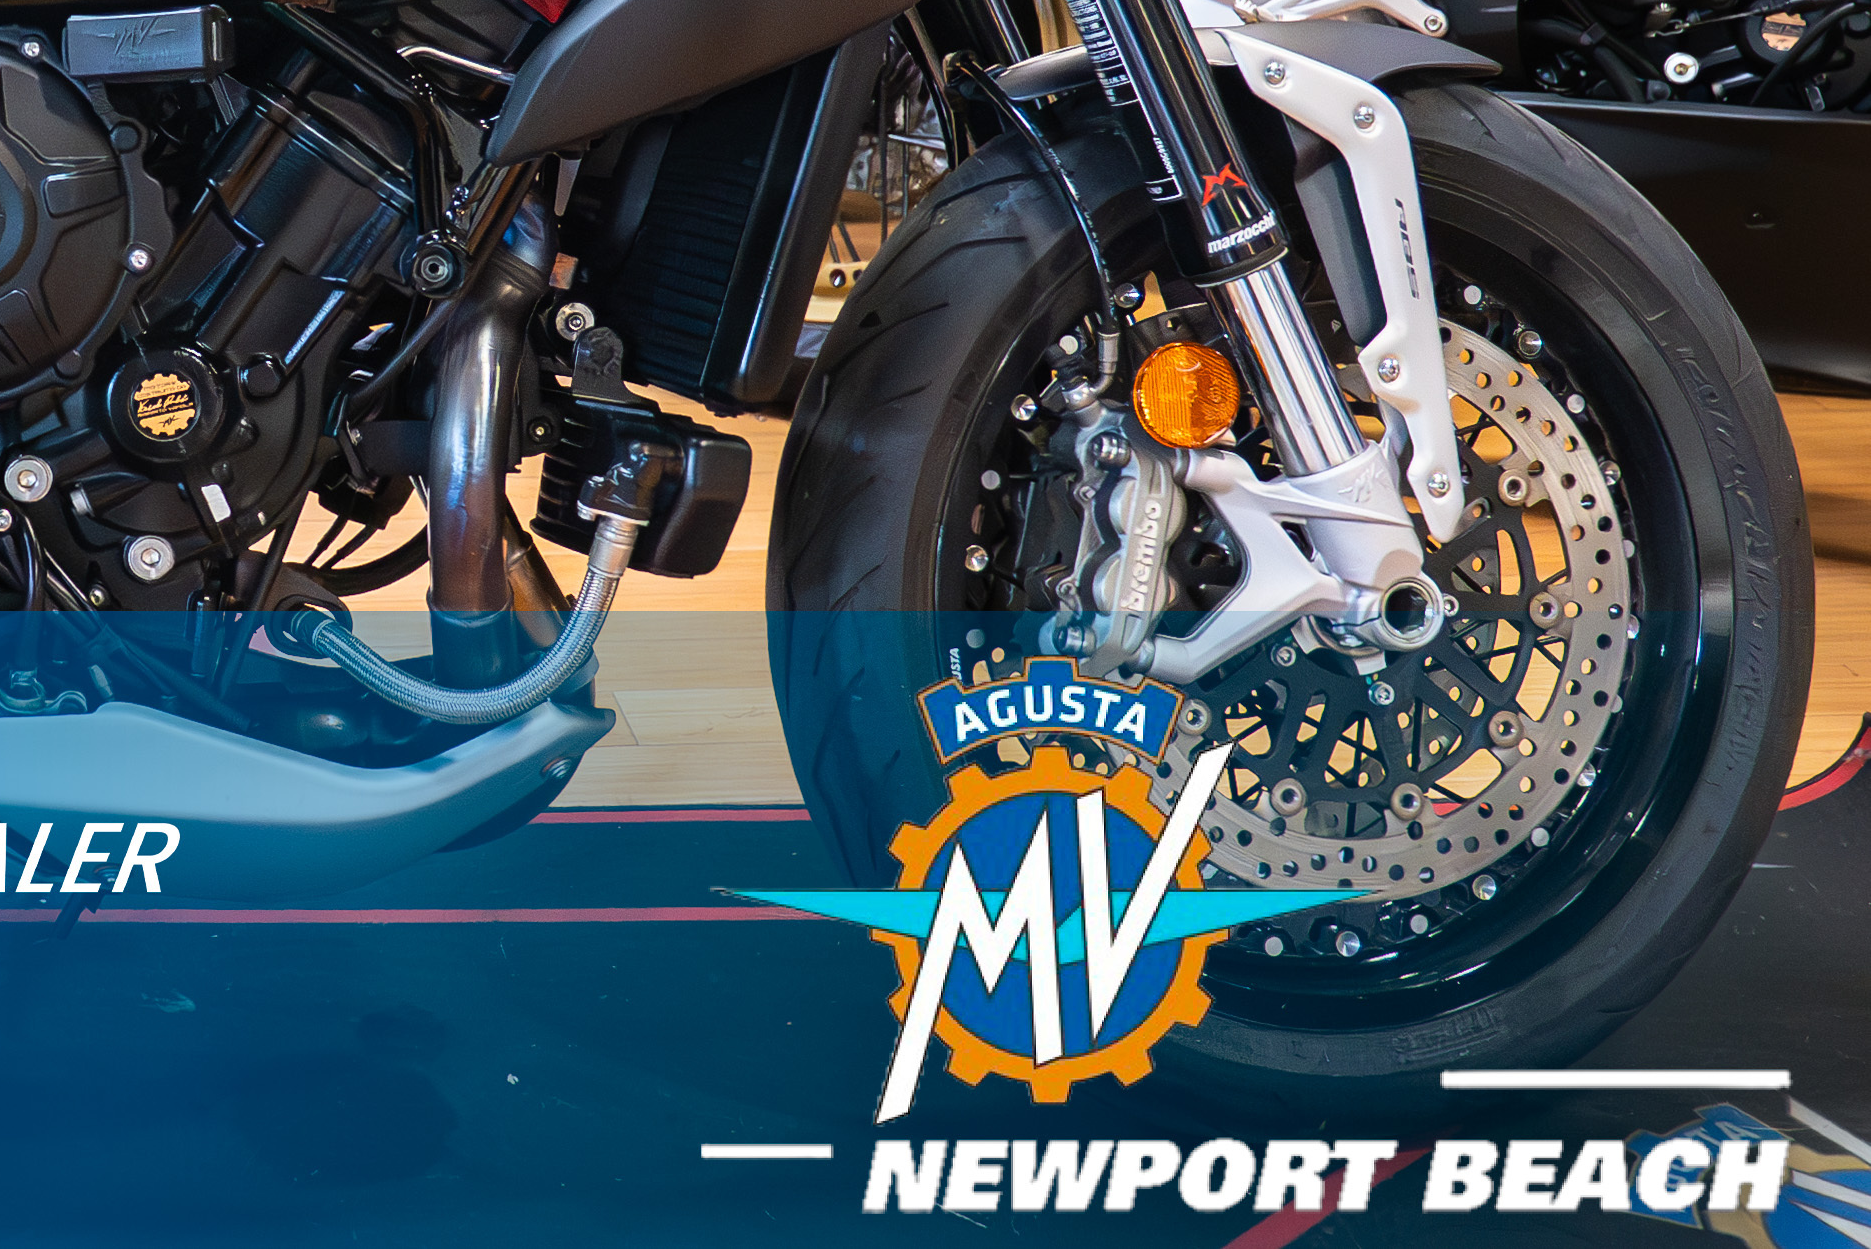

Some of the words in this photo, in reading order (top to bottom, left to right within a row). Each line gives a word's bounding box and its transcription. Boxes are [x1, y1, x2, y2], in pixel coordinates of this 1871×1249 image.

[1207, 210, 1278, 255] marzocchi
[1394, 197, 1421, 300] ABS
[1120, 500, 1163, 613] brembo
